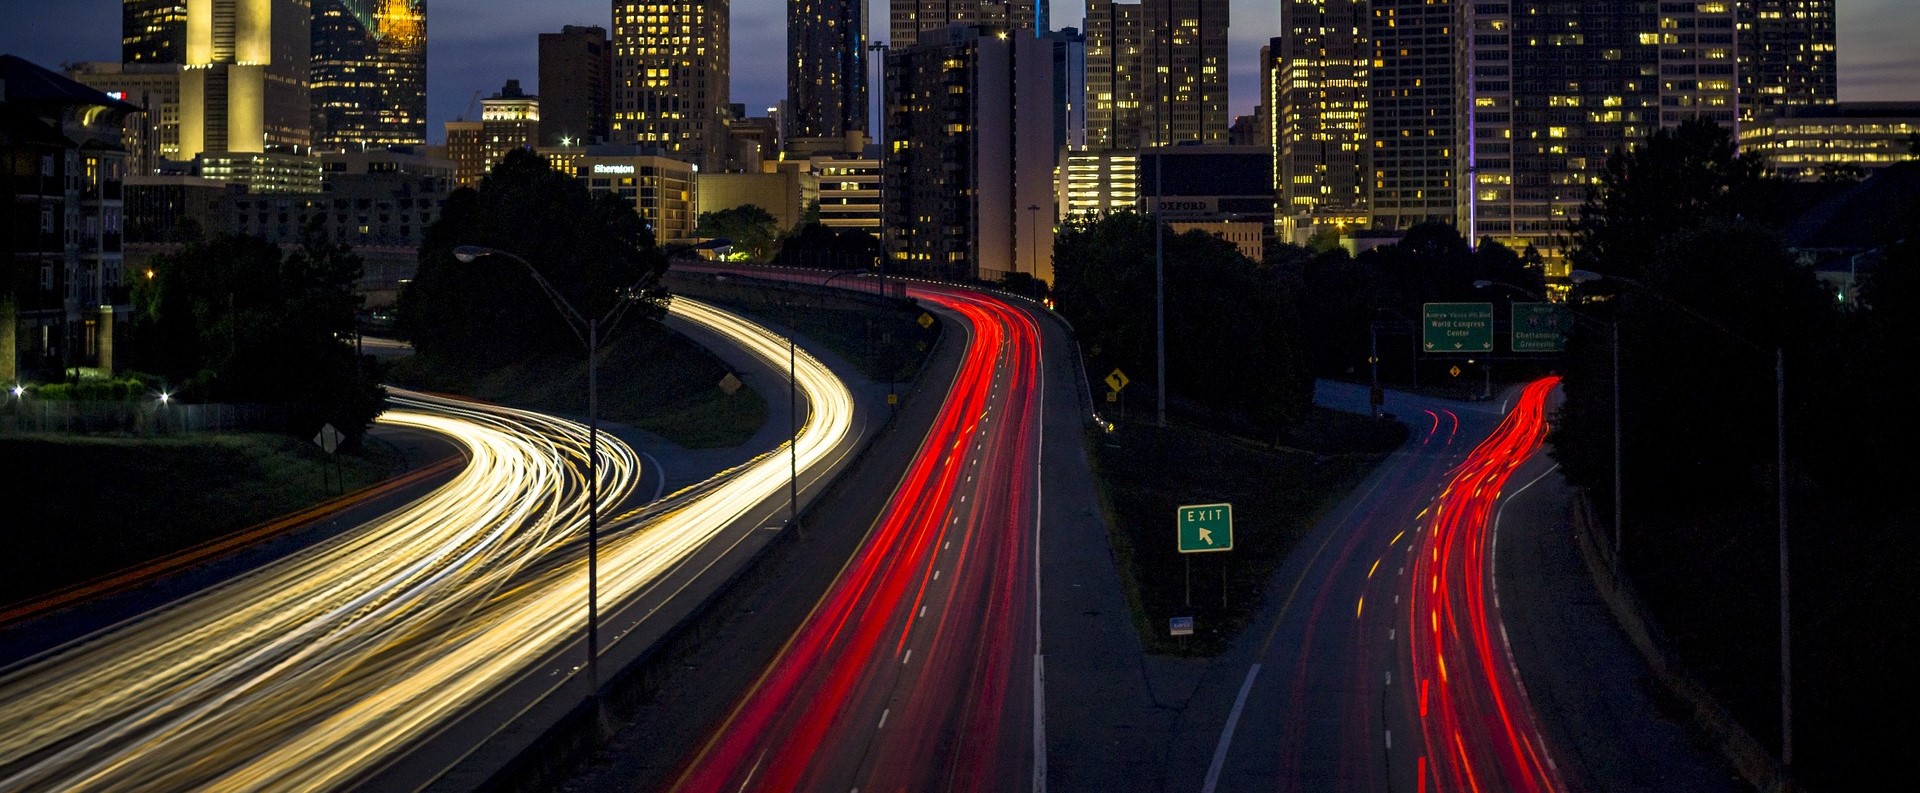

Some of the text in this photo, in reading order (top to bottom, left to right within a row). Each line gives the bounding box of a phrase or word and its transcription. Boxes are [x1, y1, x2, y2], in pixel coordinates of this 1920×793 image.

[594, 164, 635, 173] Sheraton
[1160, 202, 1206, 210] OXFORD
[1187, 509, 1222, 522] EXIT
